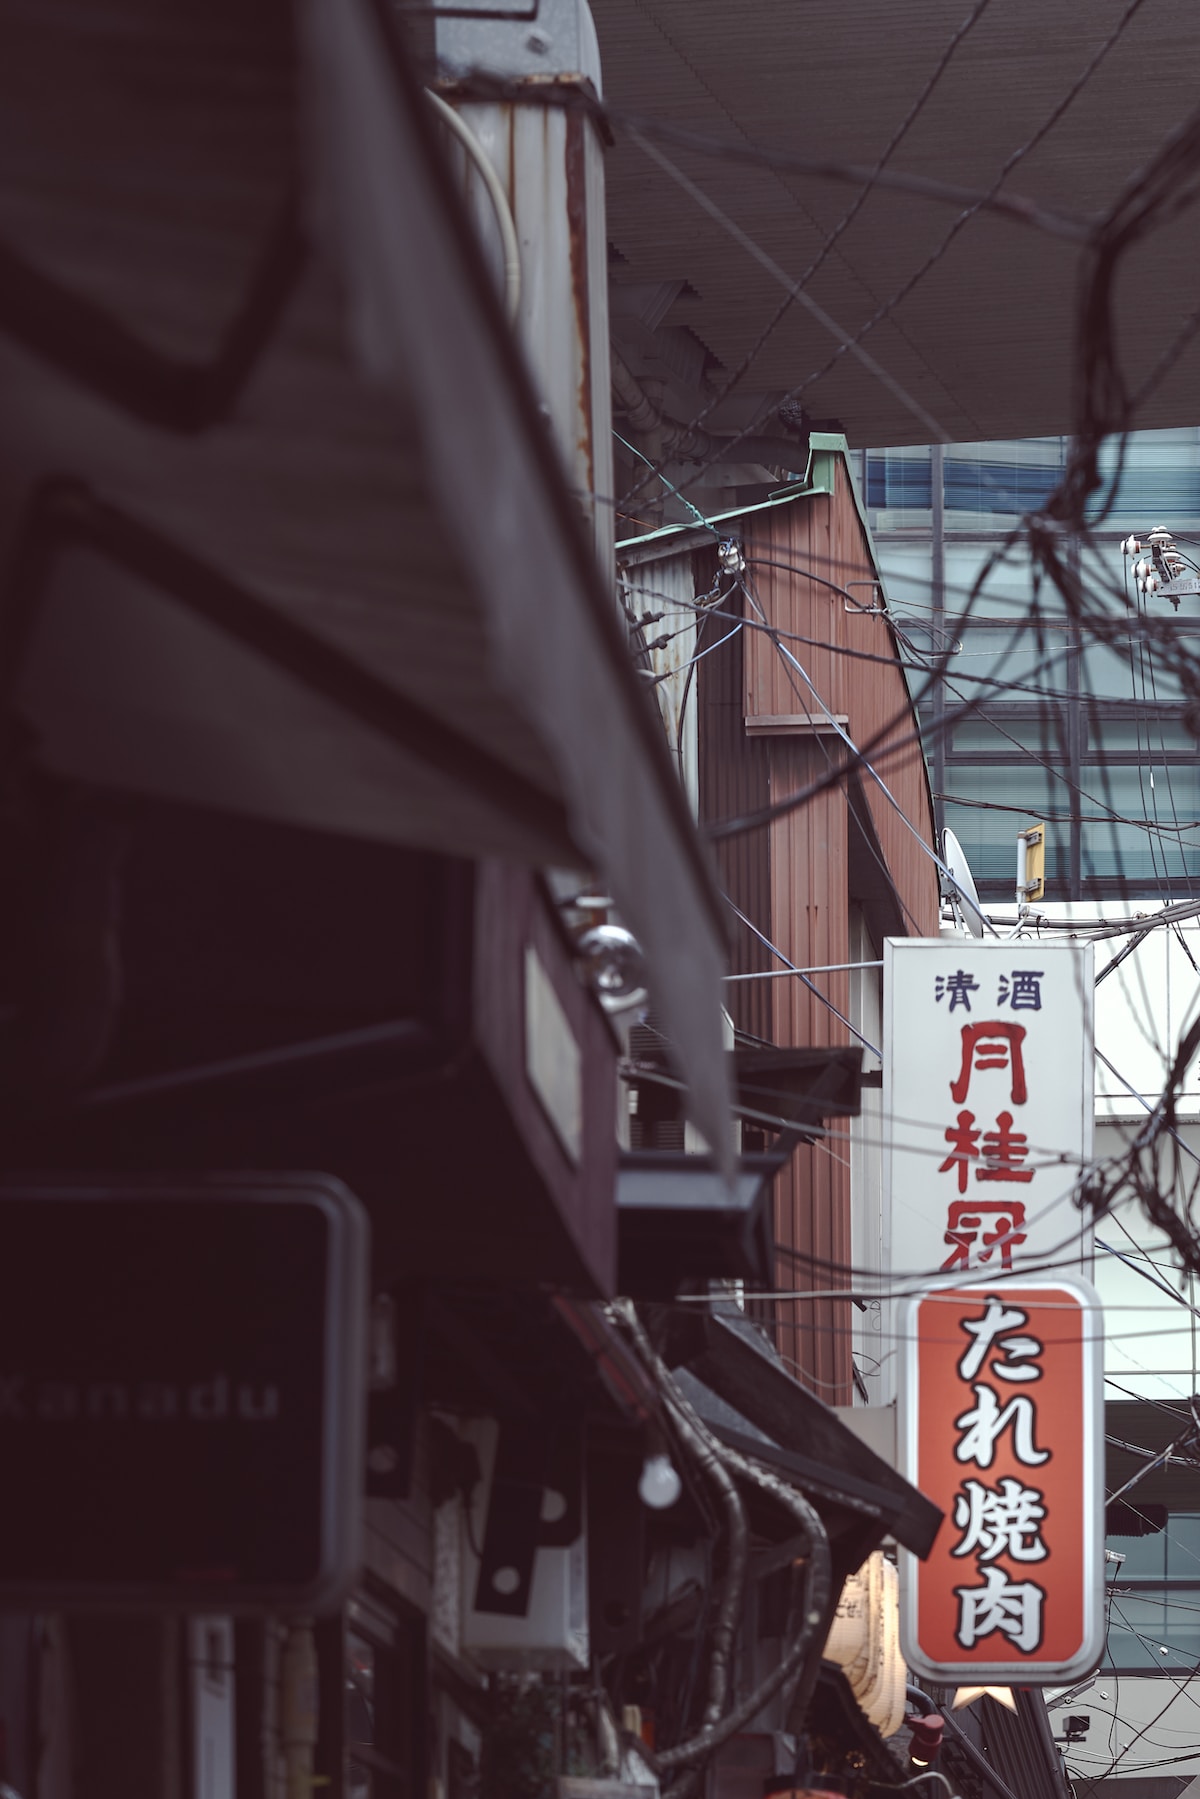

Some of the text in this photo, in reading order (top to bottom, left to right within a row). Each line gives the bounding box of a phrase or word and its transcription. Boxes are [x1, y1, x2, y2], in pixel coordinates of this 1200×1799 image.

[934, 969, 1044, 1013] 清酒
[938, 1020, 1036, 1272] 月桂冠
[951, 1294, 1051, 1653] たれ焼肉
